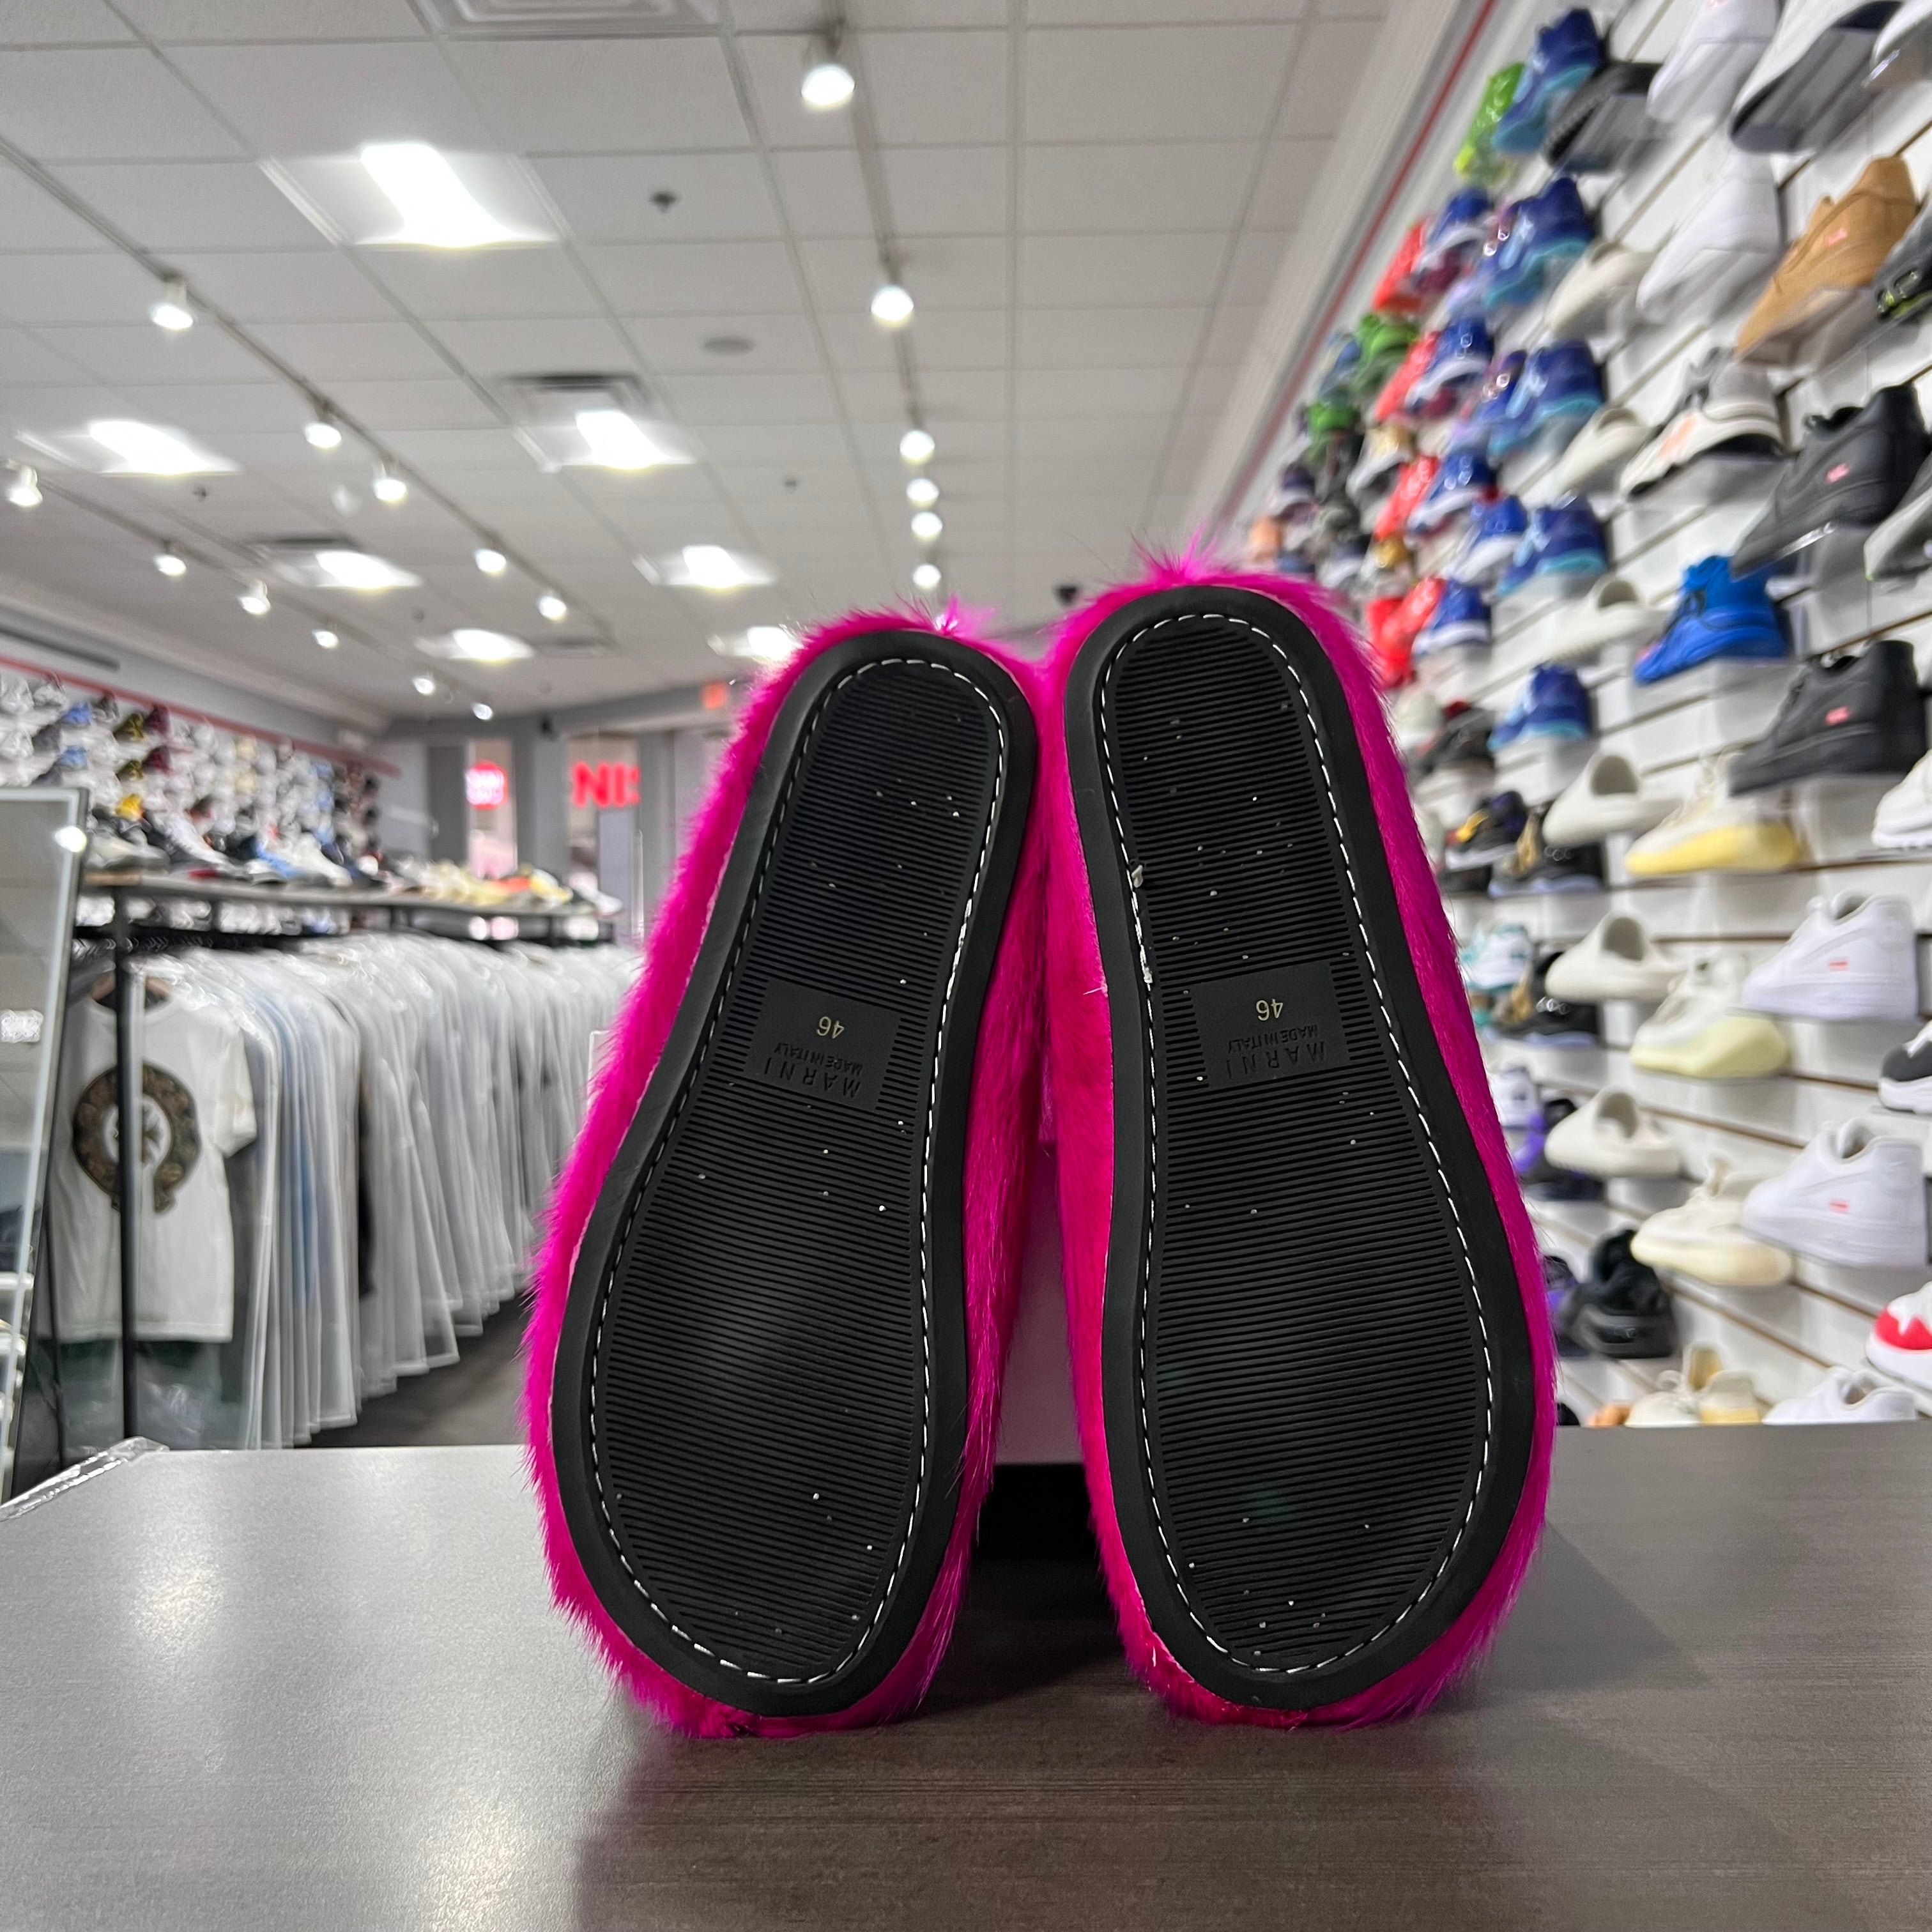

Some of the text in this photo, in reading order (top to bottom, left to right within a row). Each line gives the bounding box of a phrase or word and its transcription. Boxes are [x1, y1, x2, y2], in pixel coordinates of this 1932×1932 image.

[1255, 998, 1284, 1022] 46
[816, 1016, 845, 1039] 46
[1227, 1024, 1318, 1055] MADE IN ITALY
[773, 1042, 864, 1077] MADE IN ITALY
[1226, 1041, 1324, 1079] MARNI
[763, 1057, 862, 1098] MARNI
